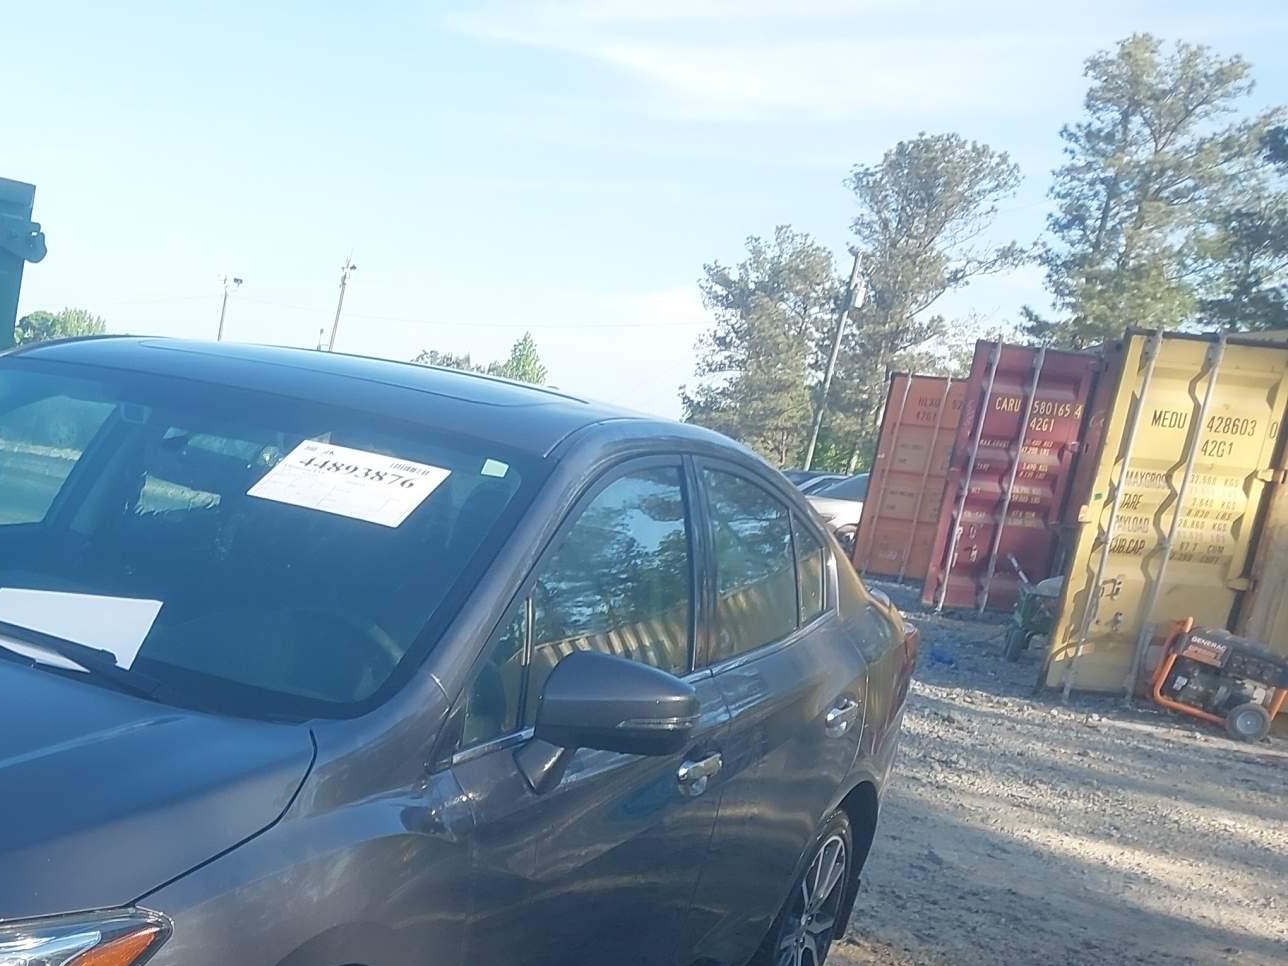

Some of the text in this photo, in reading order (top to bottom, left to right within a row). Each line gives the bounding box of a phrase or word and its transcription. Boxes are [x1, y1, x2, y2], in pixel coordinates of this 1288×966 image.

[995, 397, 1083, 420] CARU 580165 4
[1029, 417, 1055, 433] 42G1
[1152, 409, 1279, 439] MEDU 428603 0
[1200, 439, 1234, 458] 42G1
[299, 456, 415, 489] 44893876
[1120, 492, 1144, 511] TARE
[1191, 635, 1228, 651] GENERAC
